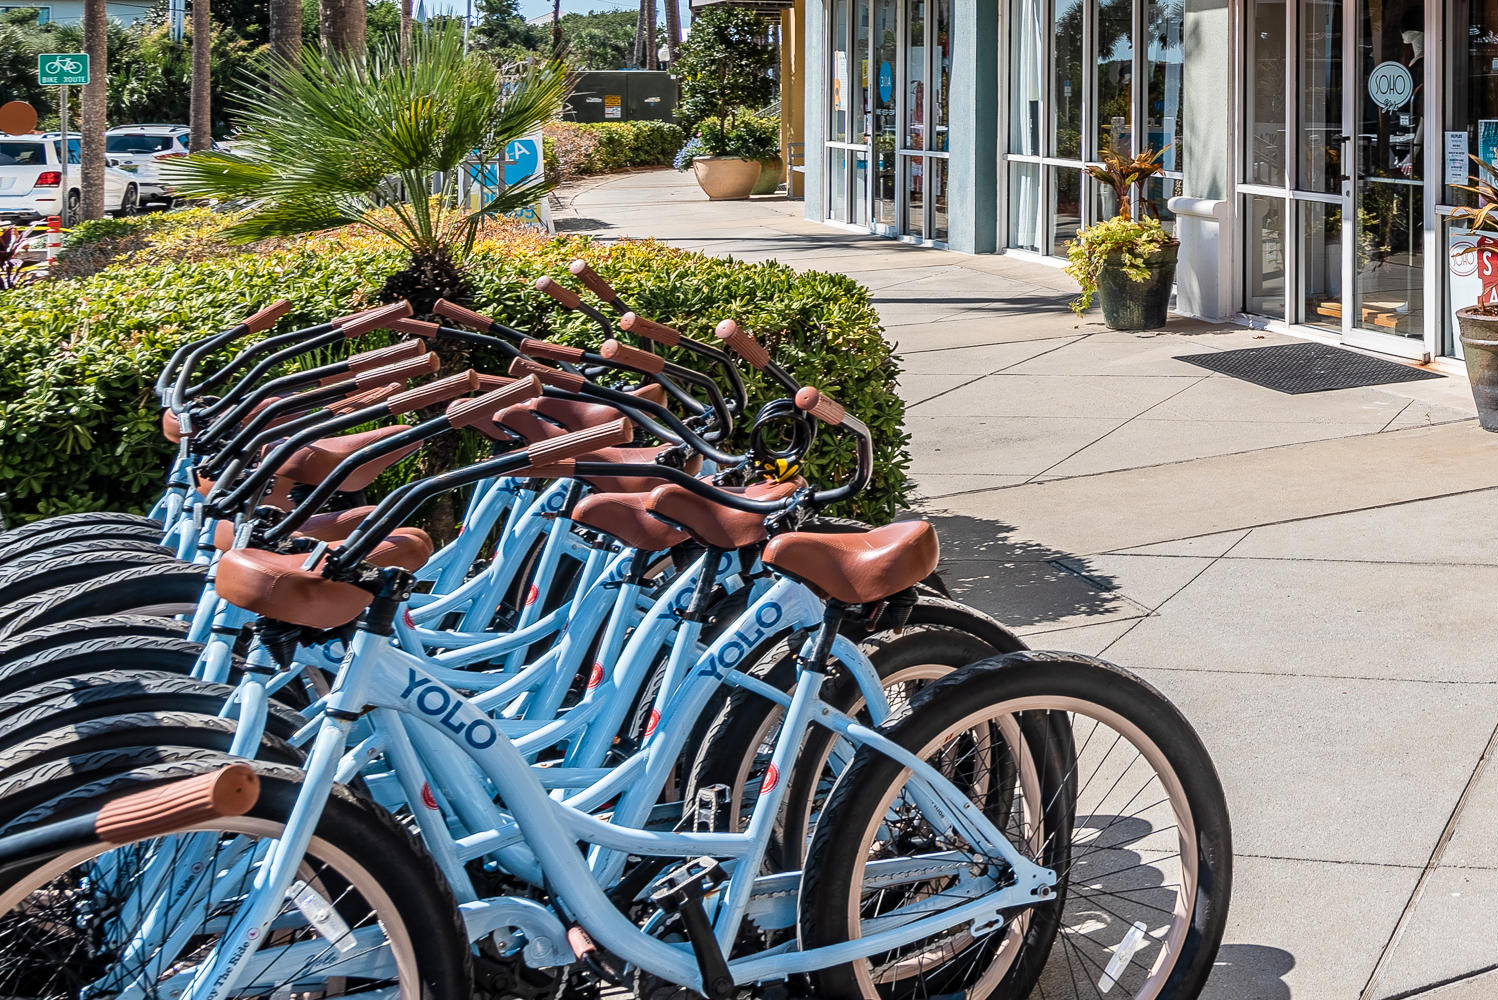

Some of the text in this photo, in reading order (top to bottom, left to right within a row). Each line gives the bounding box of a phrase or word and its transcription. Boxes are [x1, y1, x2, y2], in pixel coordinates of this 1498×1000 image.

[1375, 74, 1406, 95] SOHO
[697, 601, 783, 681] YOLO
[400, 667, 497, 750] YOLO
[213, 941, 251, 989] The Ride
